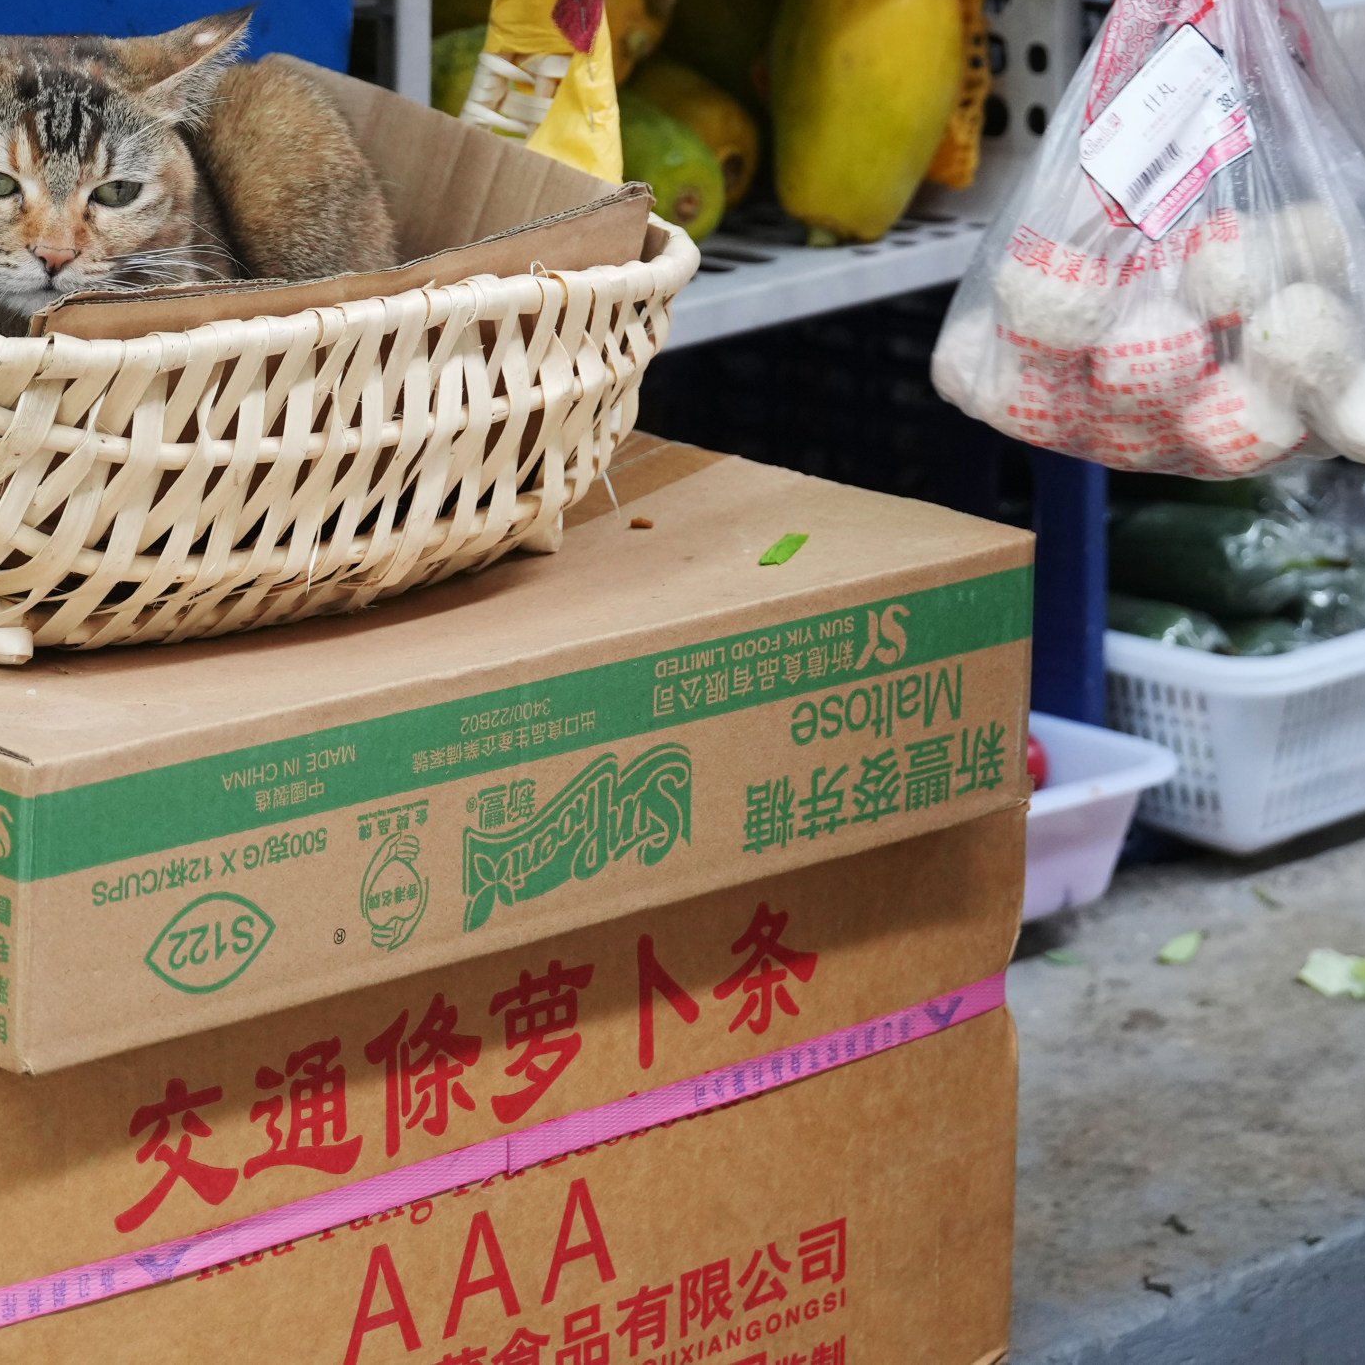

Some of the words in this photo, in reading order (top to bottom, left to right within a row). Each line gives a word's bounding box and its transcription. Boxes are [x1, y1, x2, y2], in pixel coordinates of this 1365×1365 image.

[731, 628, 781, 660] FOOD
[786, 624, 814, 647] YIK
[817, 615, 855, 642] SUN
[652, 638, 855, 717] 新億食品有限公司
[654, 643, 726, 678] LIMITED
[458, 696, 551, 735] 3400/22B02
[789, 662, 963, 747] Maltose
[304, 743, 356, 771] MADE
[412, 709, 596, 773] 出口食品生產企業備案號
[221, 762, 277, 791] CHINA
[283, 756, 300, 777] IN
[254, 776, 325, 812] 中國製造
[479, 779, 536, 829] 新豐
[742, 719, 1006, 855] 新豐麥芽糖
[219, 850, 235, 877] X
[243, 827, 328, 865] 500克/G
[91, 856, 213, 907] 12杯/CUPS
[368, 883, 418, 908] 香港名牌
[166, 913, 255, 971] S122
